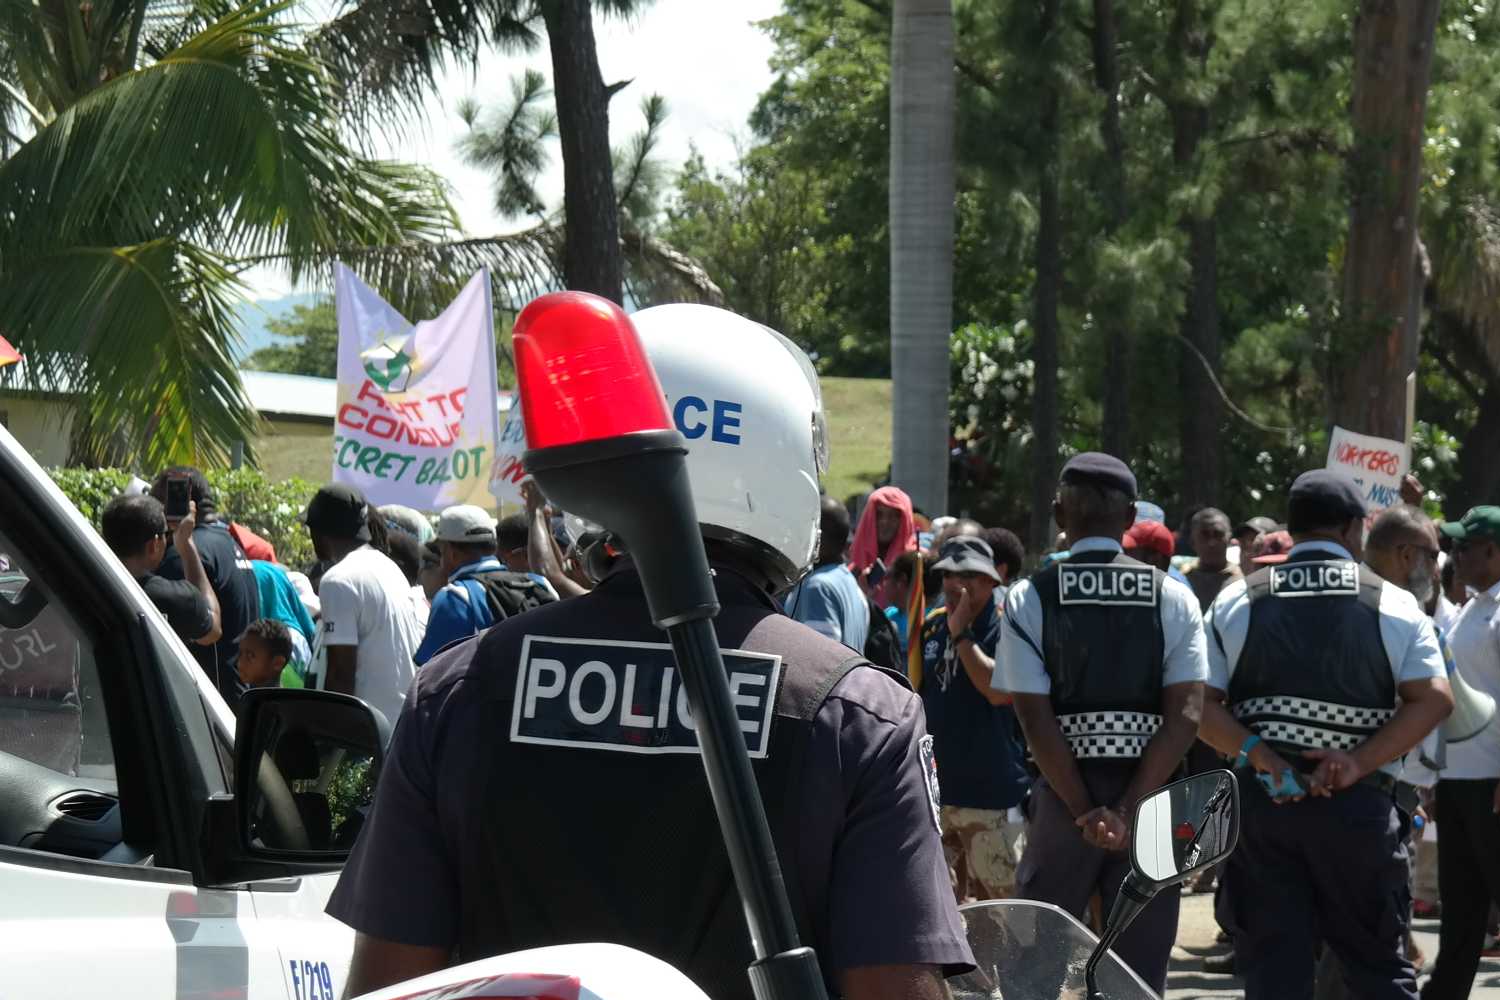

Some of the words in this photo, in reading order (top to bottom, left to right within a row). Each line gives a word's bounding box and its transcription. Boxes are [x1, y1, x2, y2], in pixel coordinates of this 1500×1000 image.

[1063, 571, 1152, 597] POLICE
[1274, 567, 1355, 590] POLICE
[0, 629, 57, 673] URL
